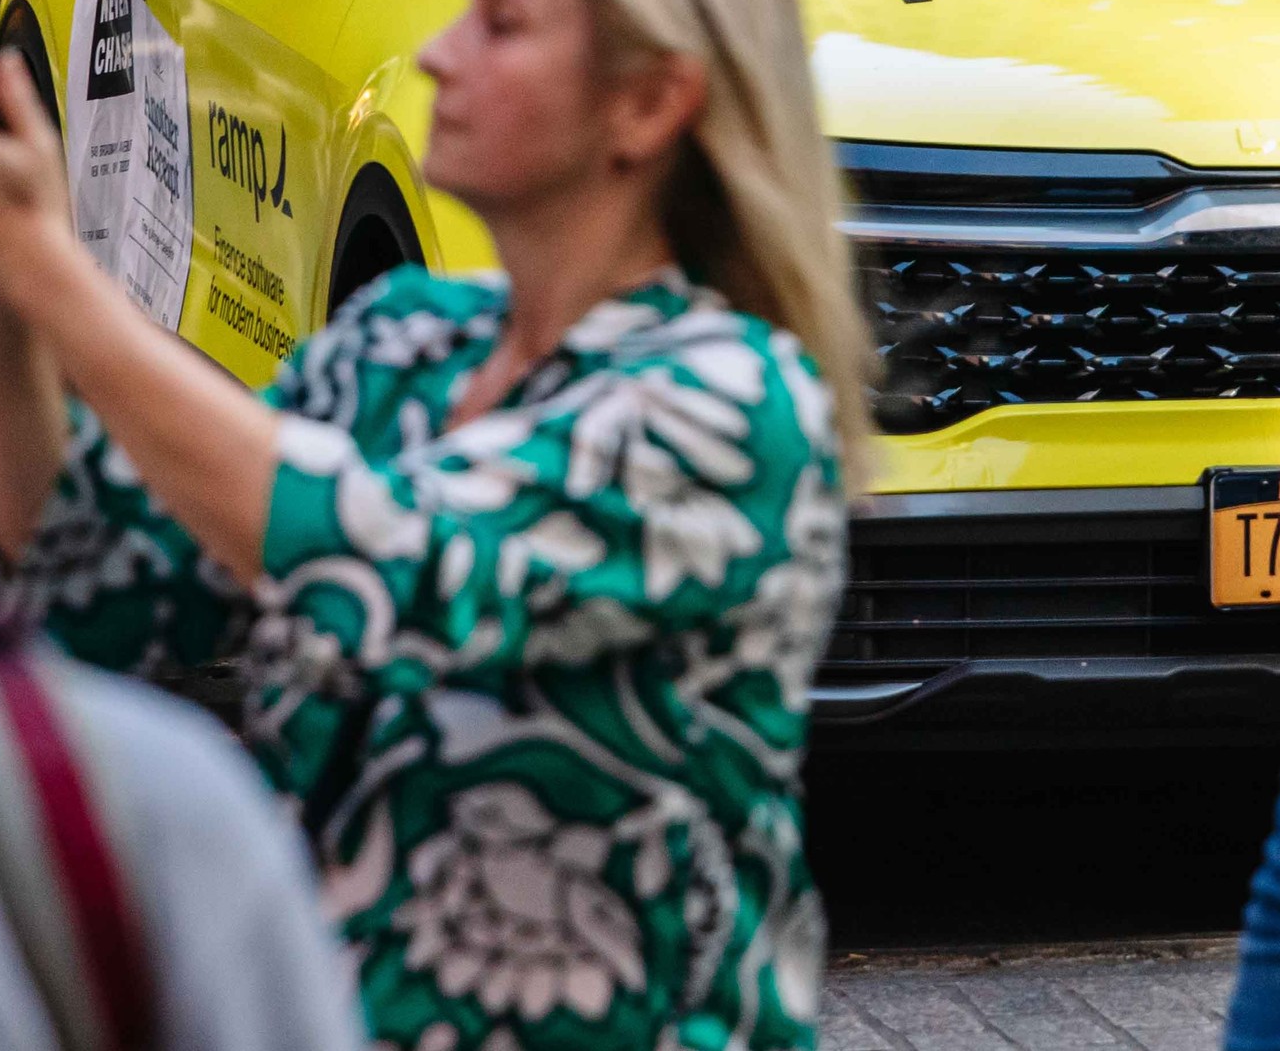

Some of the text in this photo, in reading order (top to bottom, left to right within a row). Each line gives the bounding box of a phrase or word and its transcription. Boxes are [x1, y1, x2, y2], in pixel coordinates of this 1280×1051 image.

[94, 31, 134, 76] CHASE
[209, 100, 267, 223] ramp
[214, 224, 246, 281] Finance
[247, 254, 285, 307] software
[207, 274, 222, 316] for
[220, 294, 255, 341] modern
